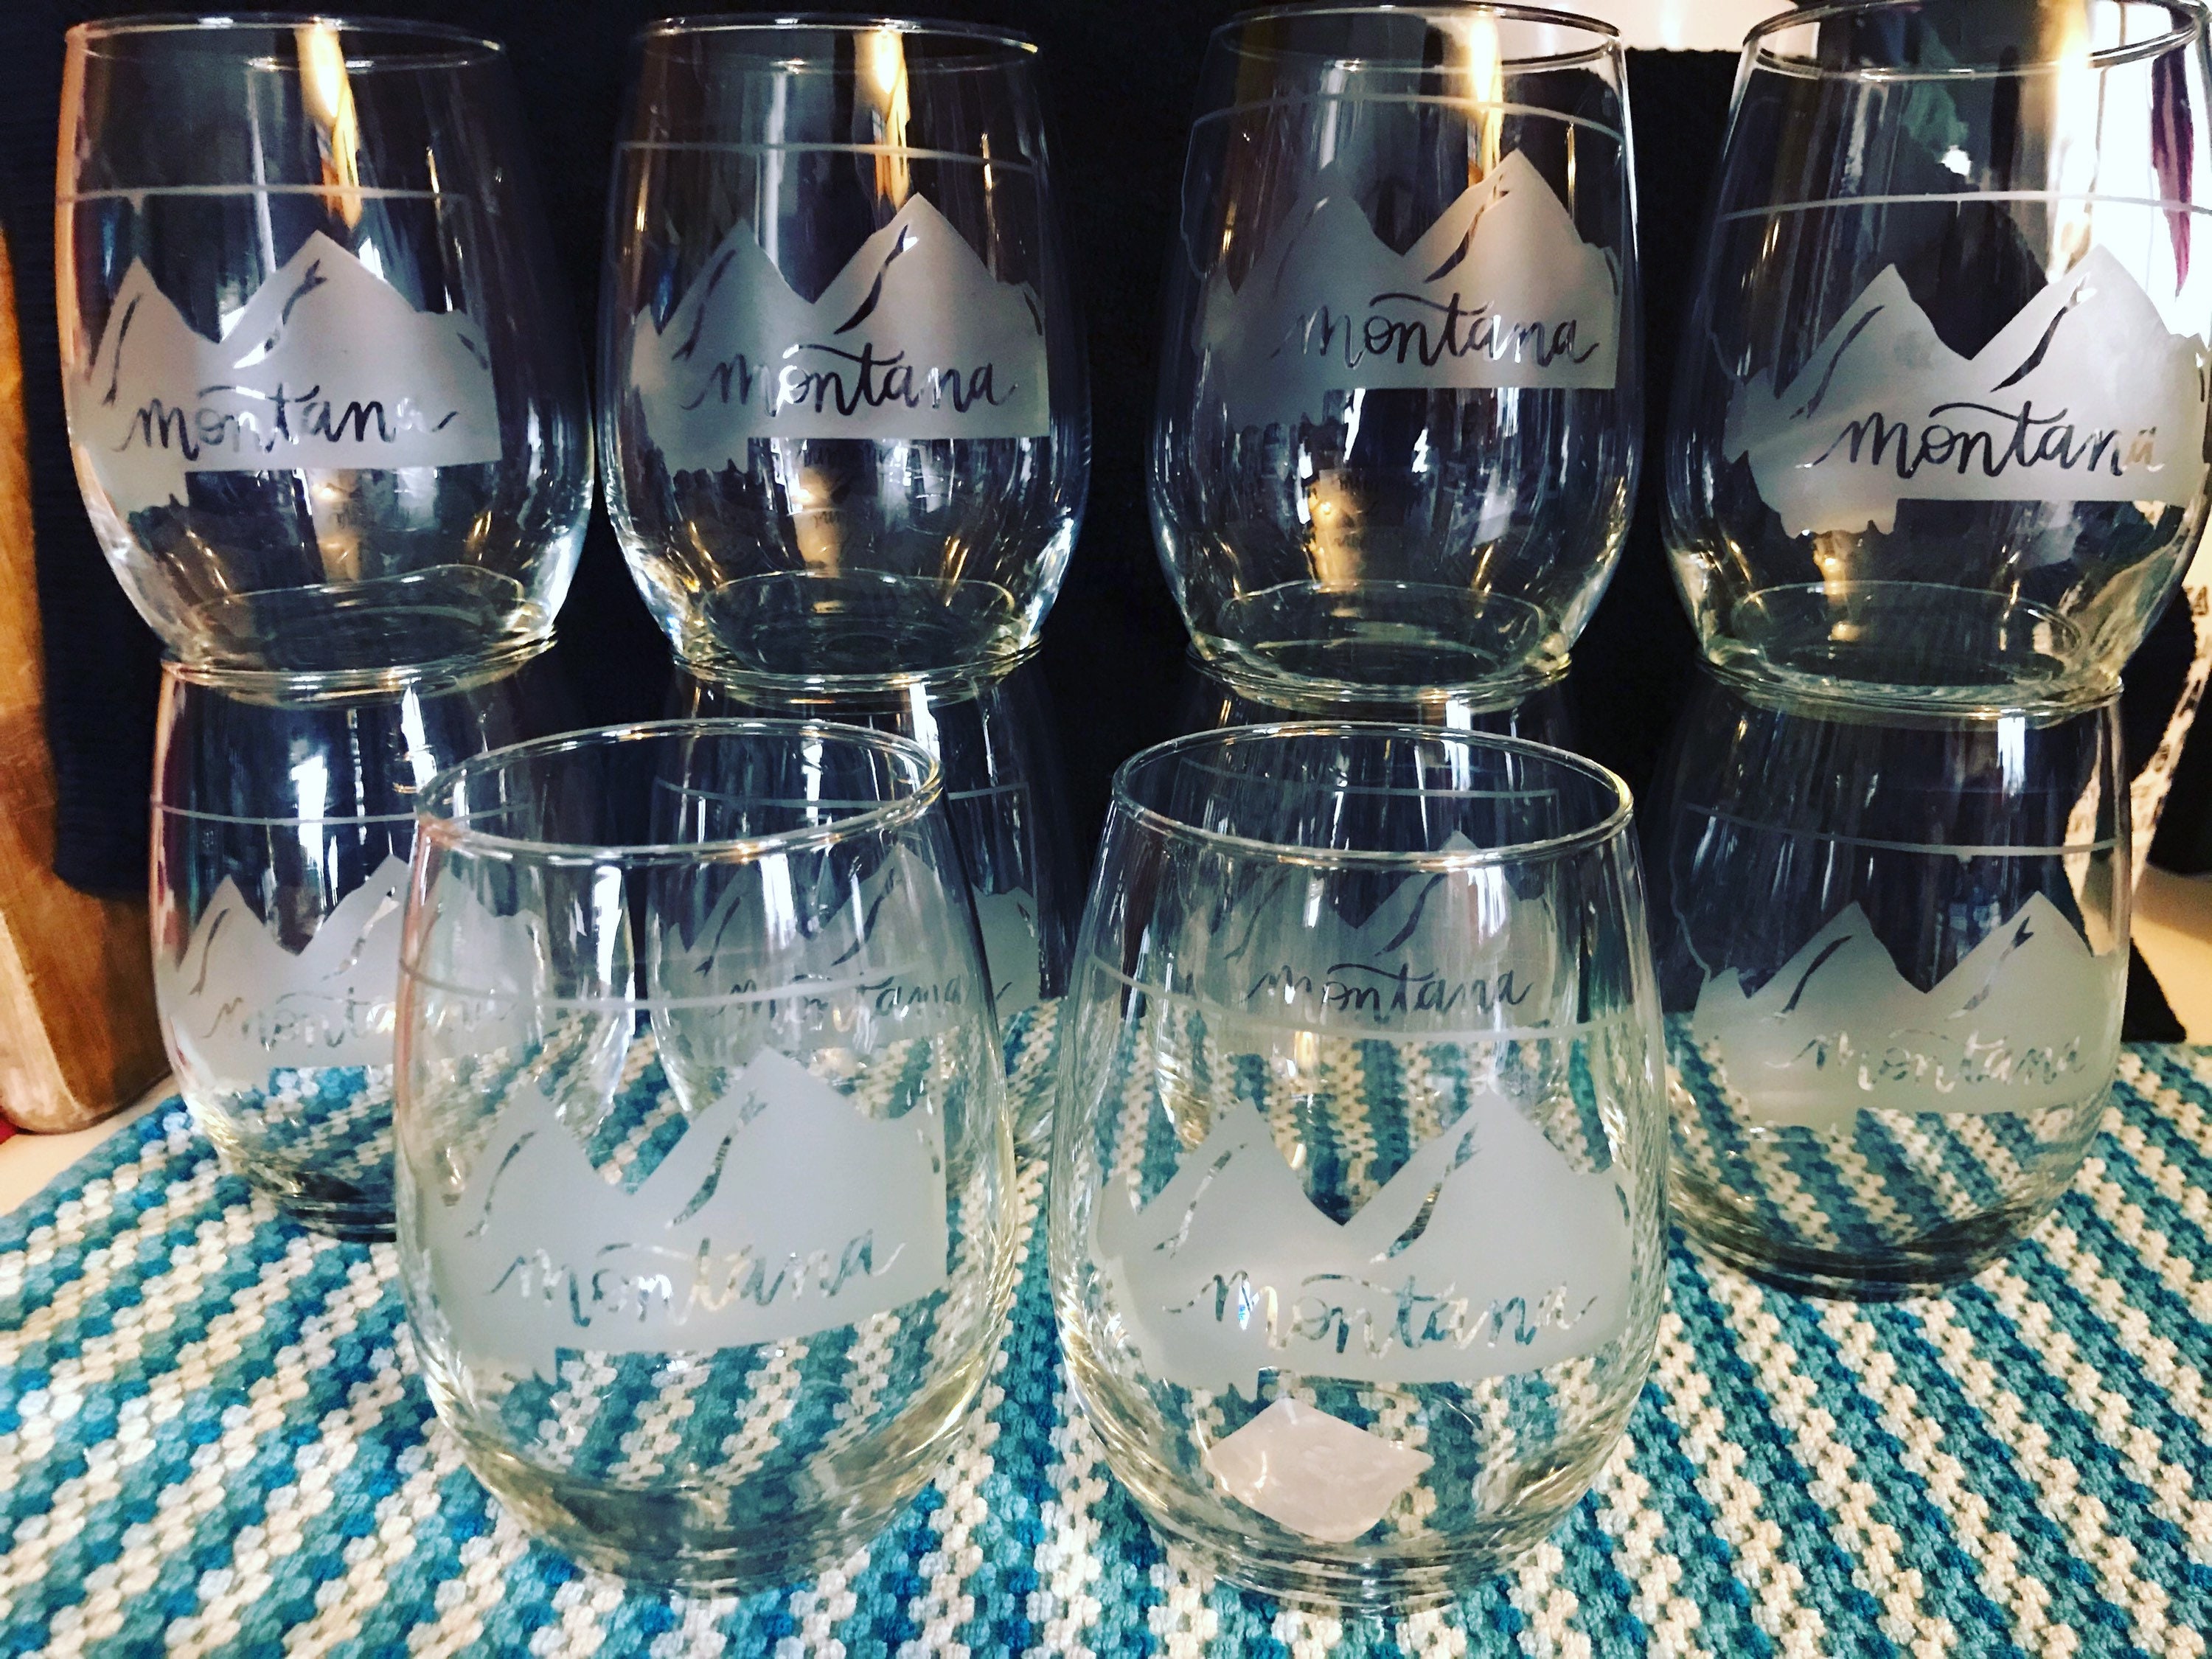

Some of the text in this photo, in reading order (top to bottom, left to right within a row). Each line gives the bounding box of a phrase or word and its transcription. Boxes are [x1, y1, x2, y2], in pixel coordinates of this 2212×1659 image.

[1266, 293, 1600, 369] montana
[679, 342, 1020, 417] montana
[111, 382, 459, 461] montana
[1795, 400, 2166, 479] montana
[1247, 962, 1534, 1024] montana
[484, 1237, 907, 1327] montana
[1162, 1271, 1599, 1361] montana
